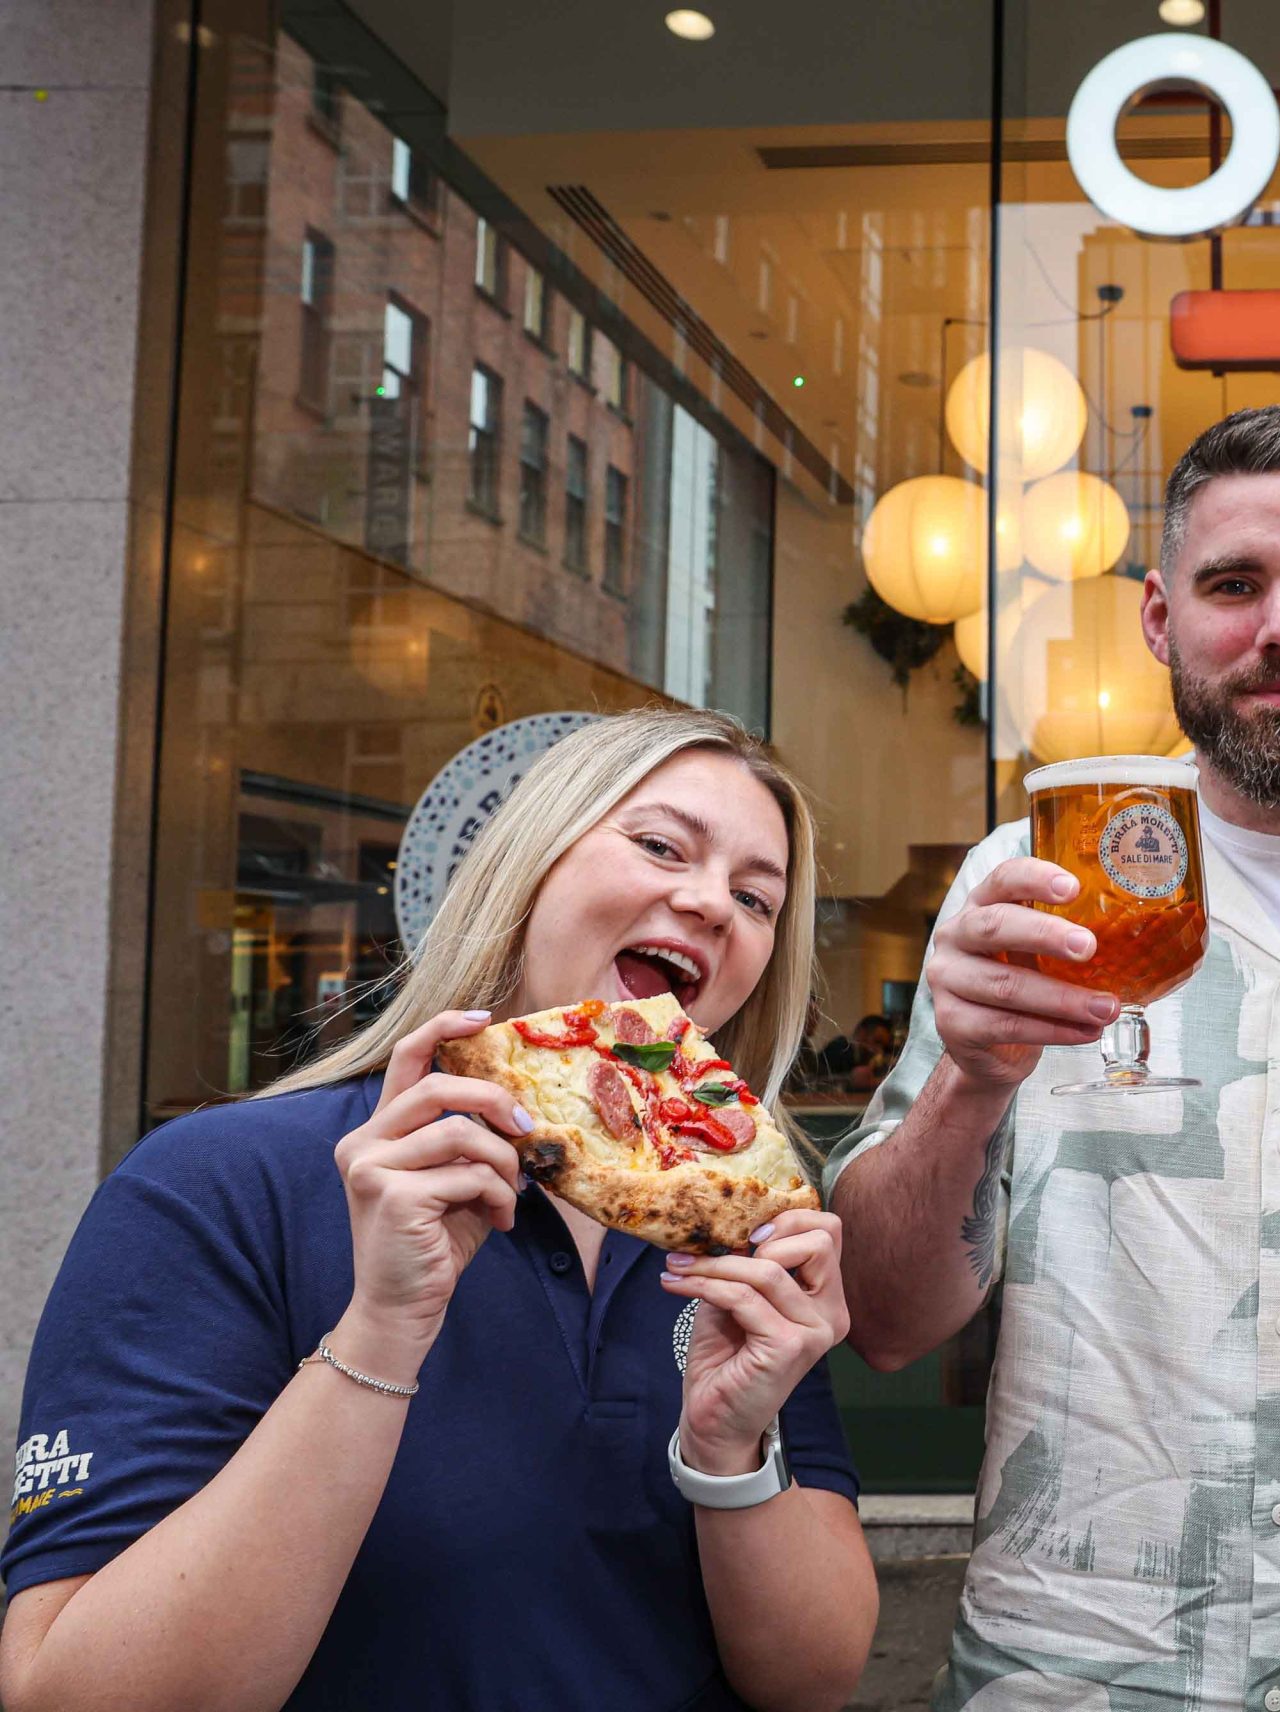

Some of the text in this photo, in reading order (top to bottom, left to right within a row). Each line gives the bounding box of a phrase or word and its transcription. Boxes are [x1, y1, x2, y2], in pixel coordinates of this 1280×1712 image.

[1111, 819, 1137, 853] BIRRA
[1140, 816, 1179, 854] MORETTI
[1120, 854, 1173, 864] SALE DI MARE
[11, 1452, 94, 1504] ETTI
